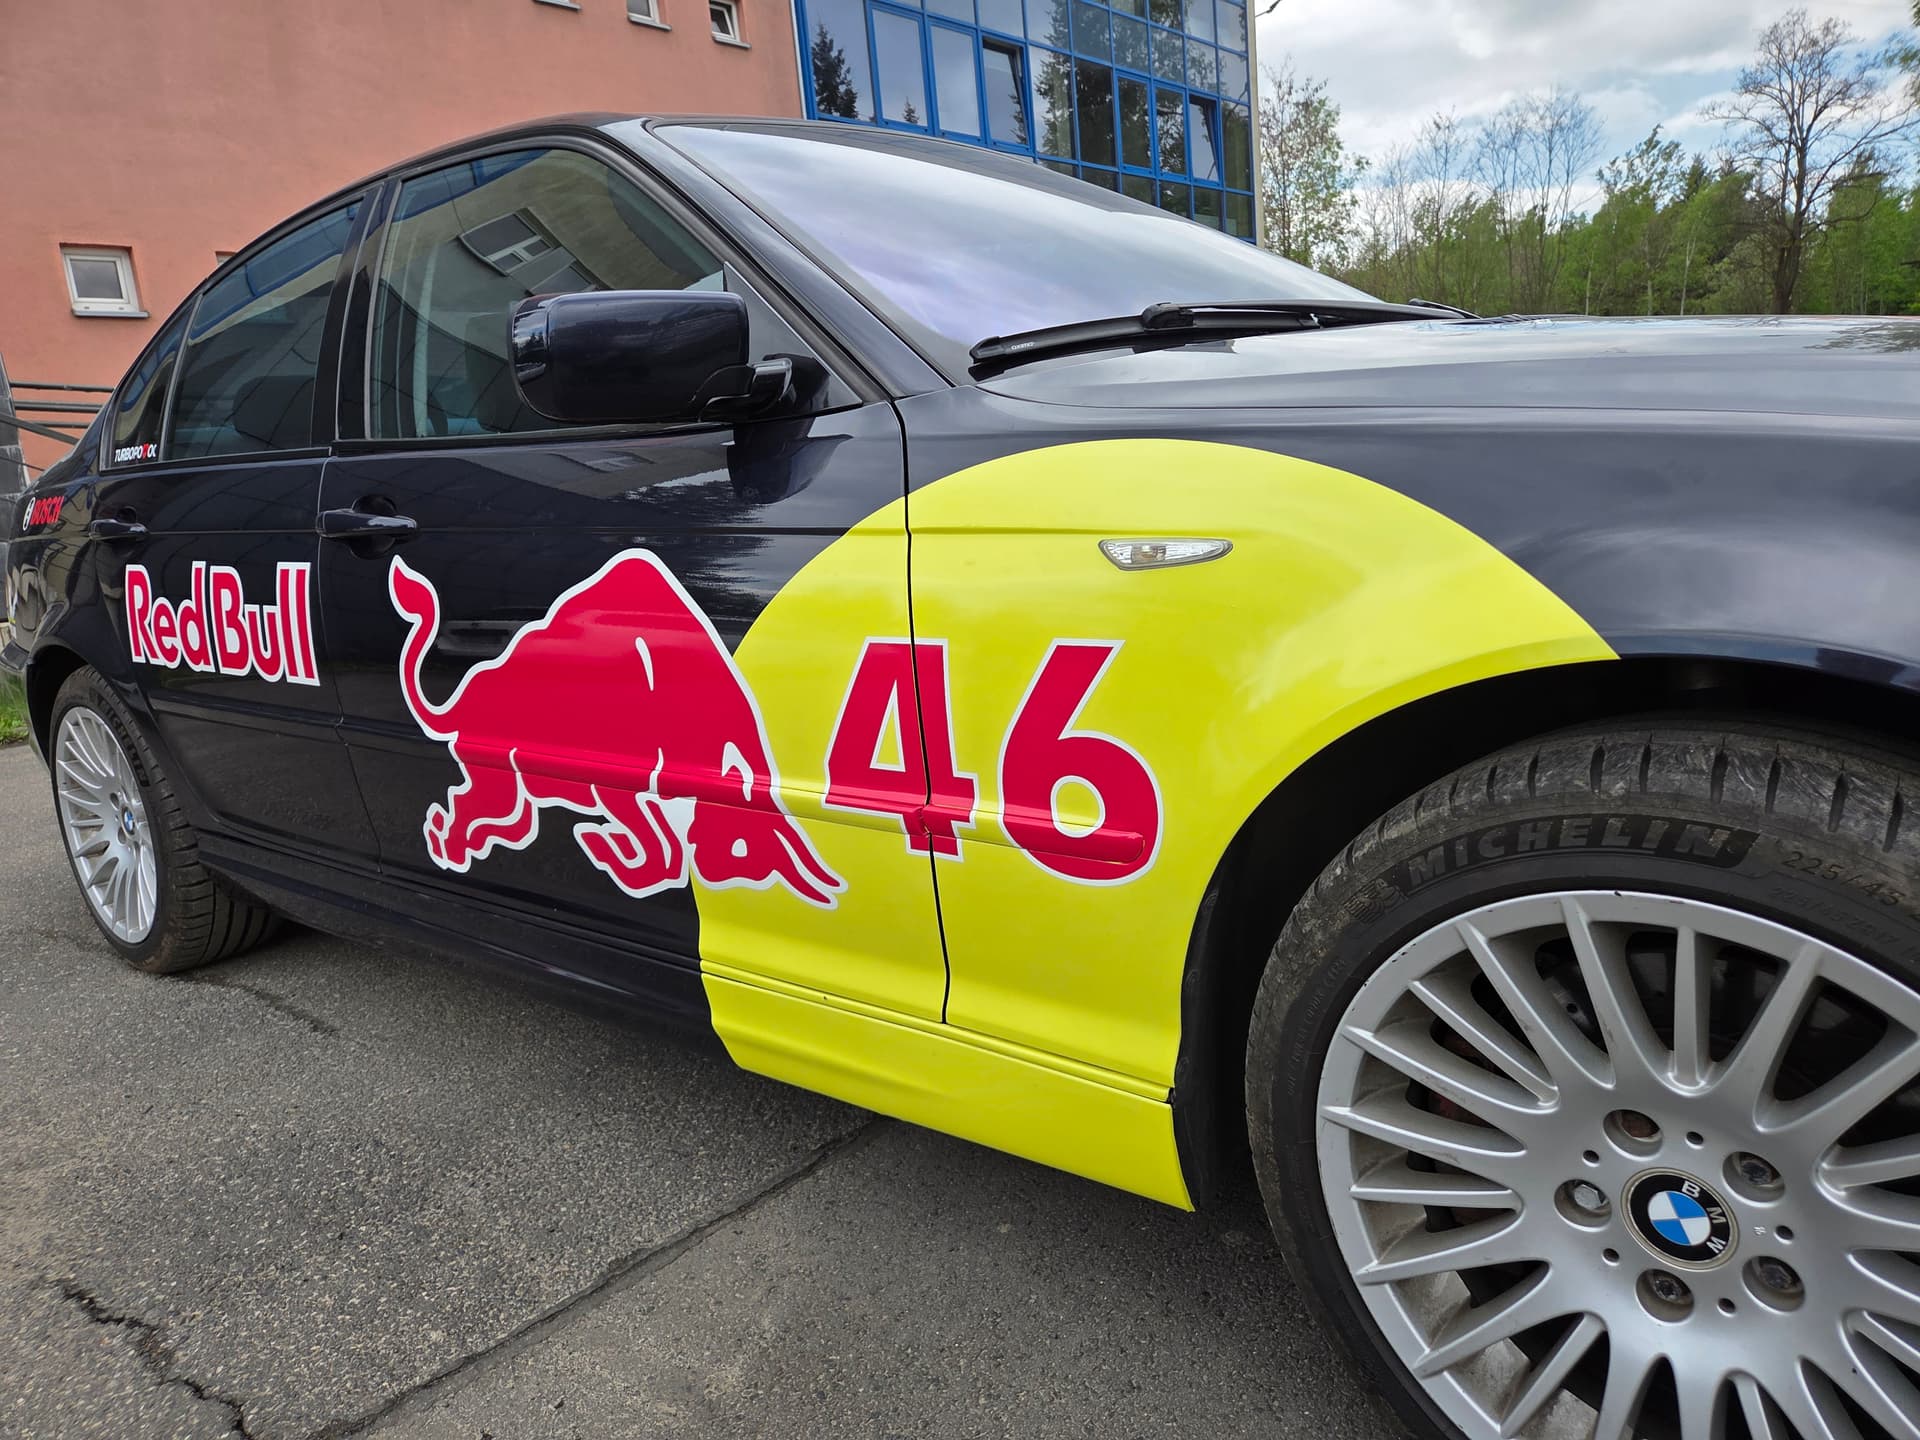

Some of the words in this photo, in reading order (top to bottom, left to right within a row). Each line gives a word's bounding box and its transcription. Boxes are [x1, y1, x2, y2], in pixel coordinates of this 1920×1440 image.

[30, 496, 65, 526] BOSCH
[125, 561, 216, 673] Red
[210, 562, 320, 686] Bull
[821, 637, 1164, 886] 46
[1407, 816, 1730, 887] MICHELIN
[1682, 1180, 1727, 1253] BMW
